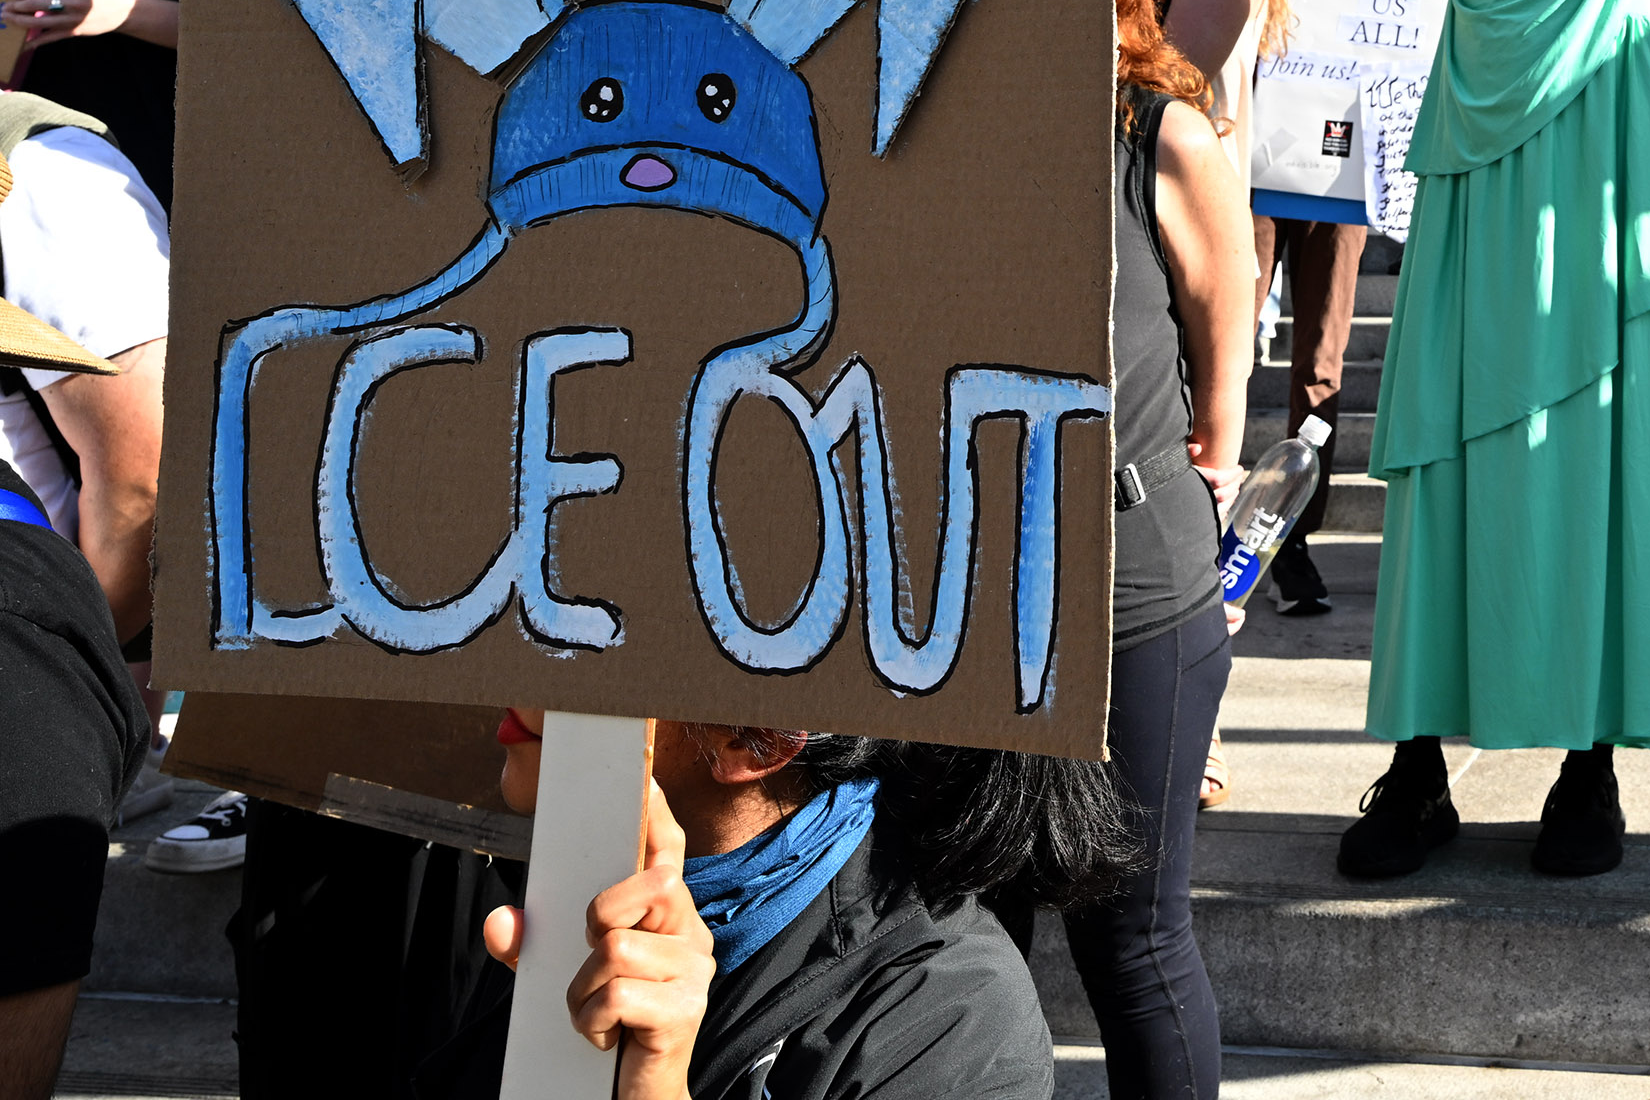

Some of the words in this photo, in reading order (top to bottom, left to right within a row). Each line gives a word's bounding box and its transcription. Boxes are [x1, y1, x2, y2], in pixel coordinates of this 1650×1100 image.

[1349, 21, 1419, 49] ALL!
[1263, 56, 1313, 78] Join
[1322, 60, 1357, 81] us!
[210, 307, 633, 660] ICE
[680, 353, 1112, 715] OUT
[1221, 506, 1278, 590] smart
[1259, 516, 1286, 552] water
